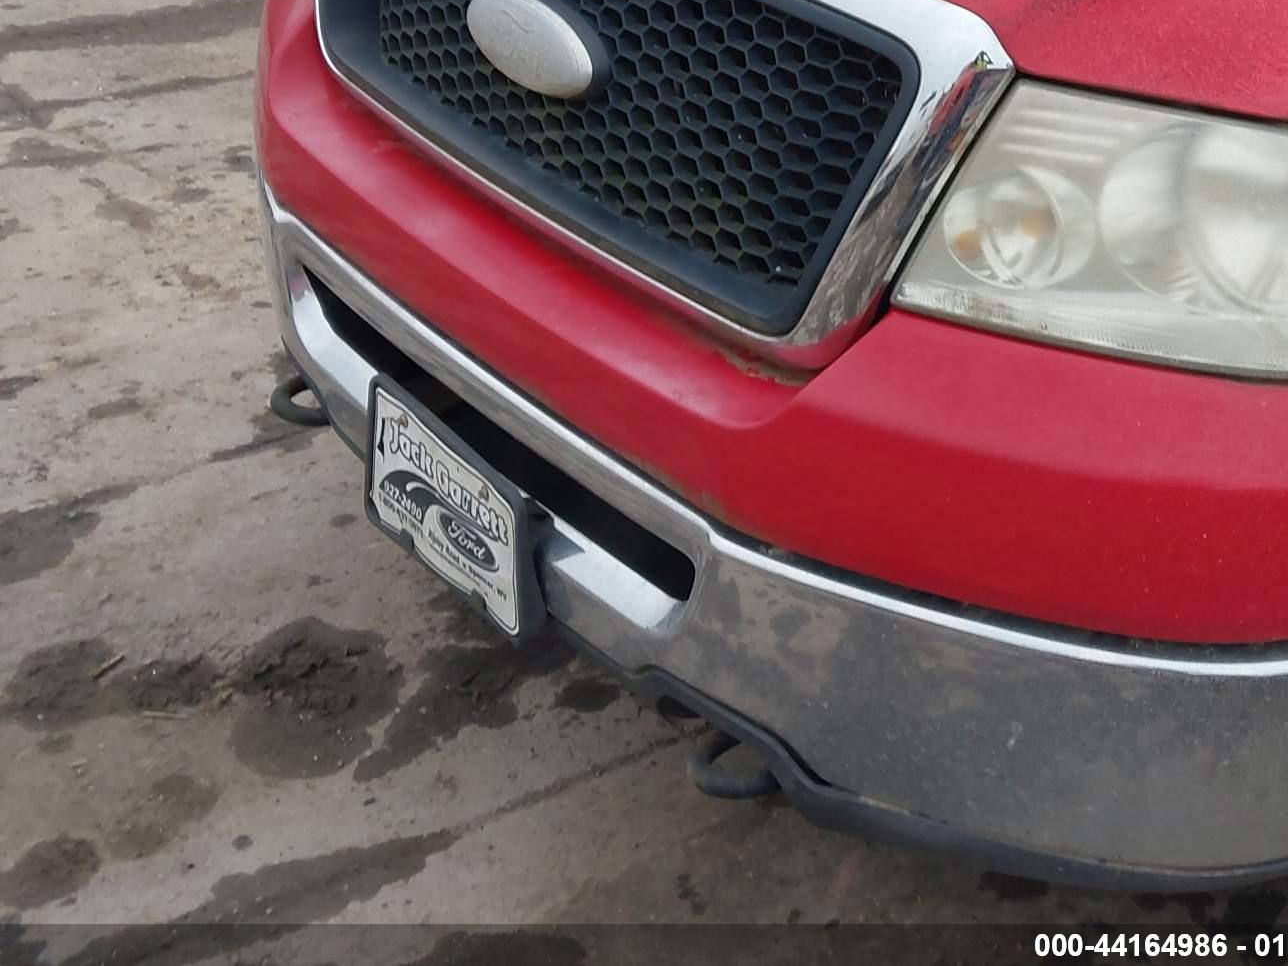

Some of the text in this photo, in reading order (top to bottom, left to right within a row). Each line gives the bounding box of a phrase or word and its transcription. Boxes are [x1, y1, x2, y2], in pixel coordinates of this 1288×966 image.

[389, 416, 434, 479] Jack
[436, 460, 509, 547] Garrett
[448, 520, 486, 560] Ford
